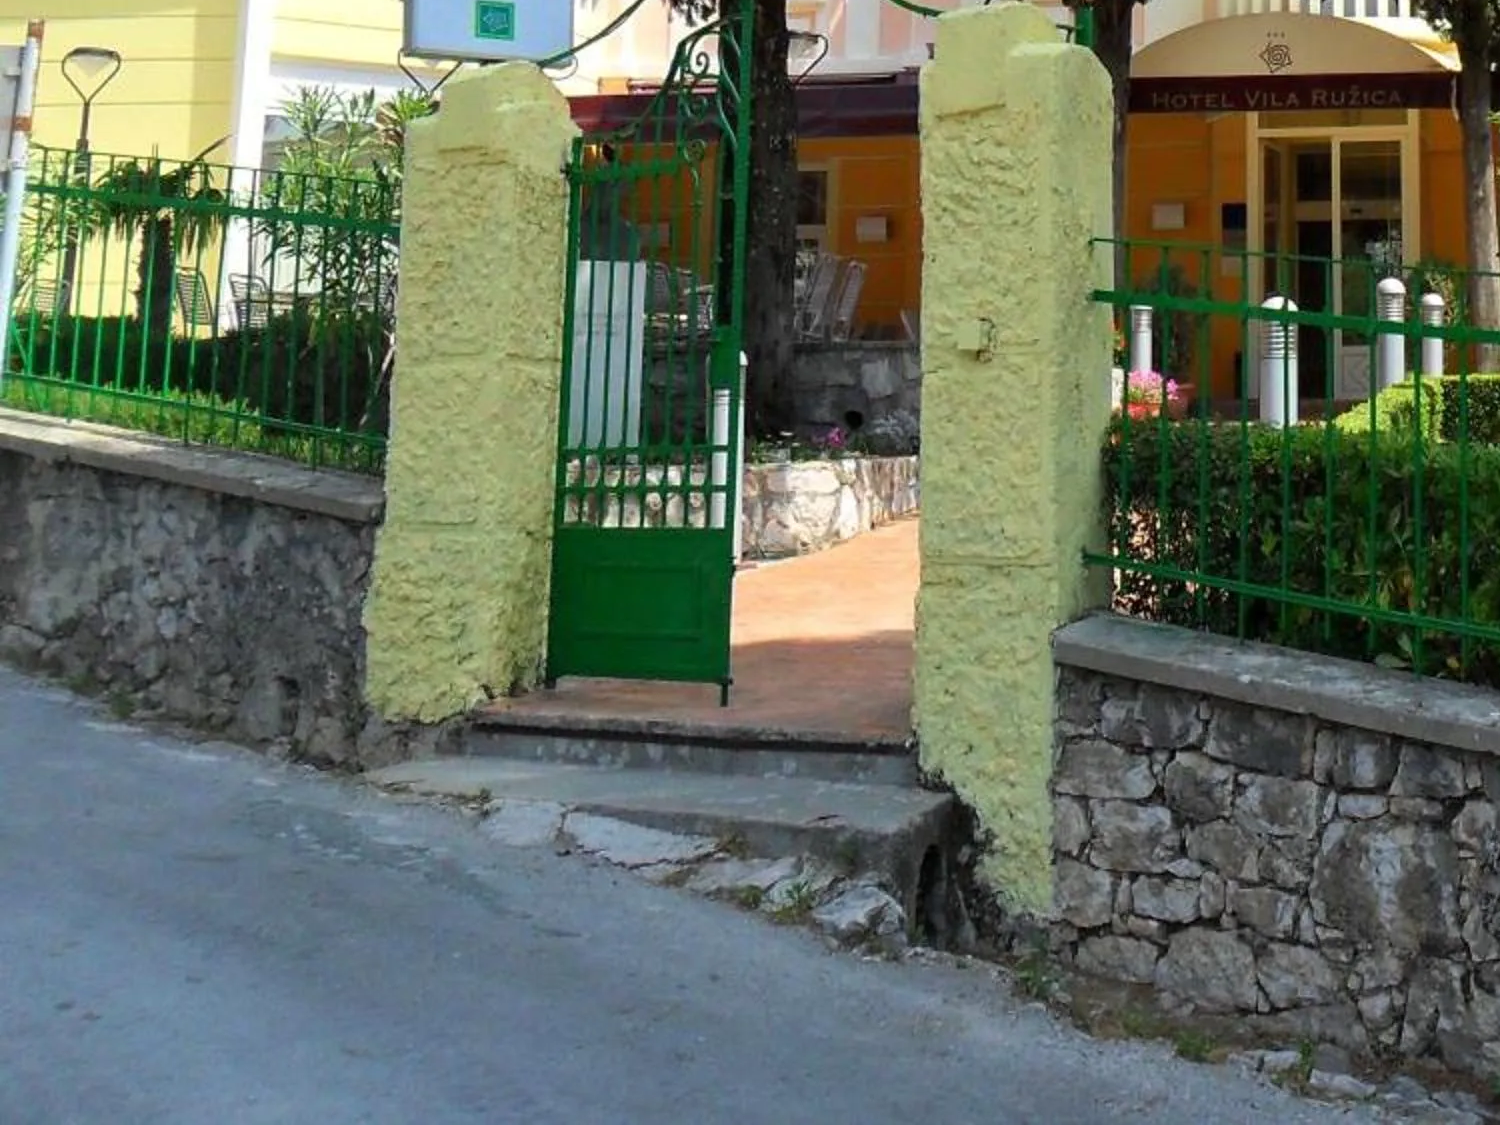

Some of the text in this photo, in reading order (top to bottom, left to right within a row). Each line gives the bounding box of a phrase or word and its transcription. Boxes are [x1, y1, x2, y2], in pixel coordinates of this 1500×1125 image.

[1151, 84, 1403, 110] HOTEL VILA RUŽICA
